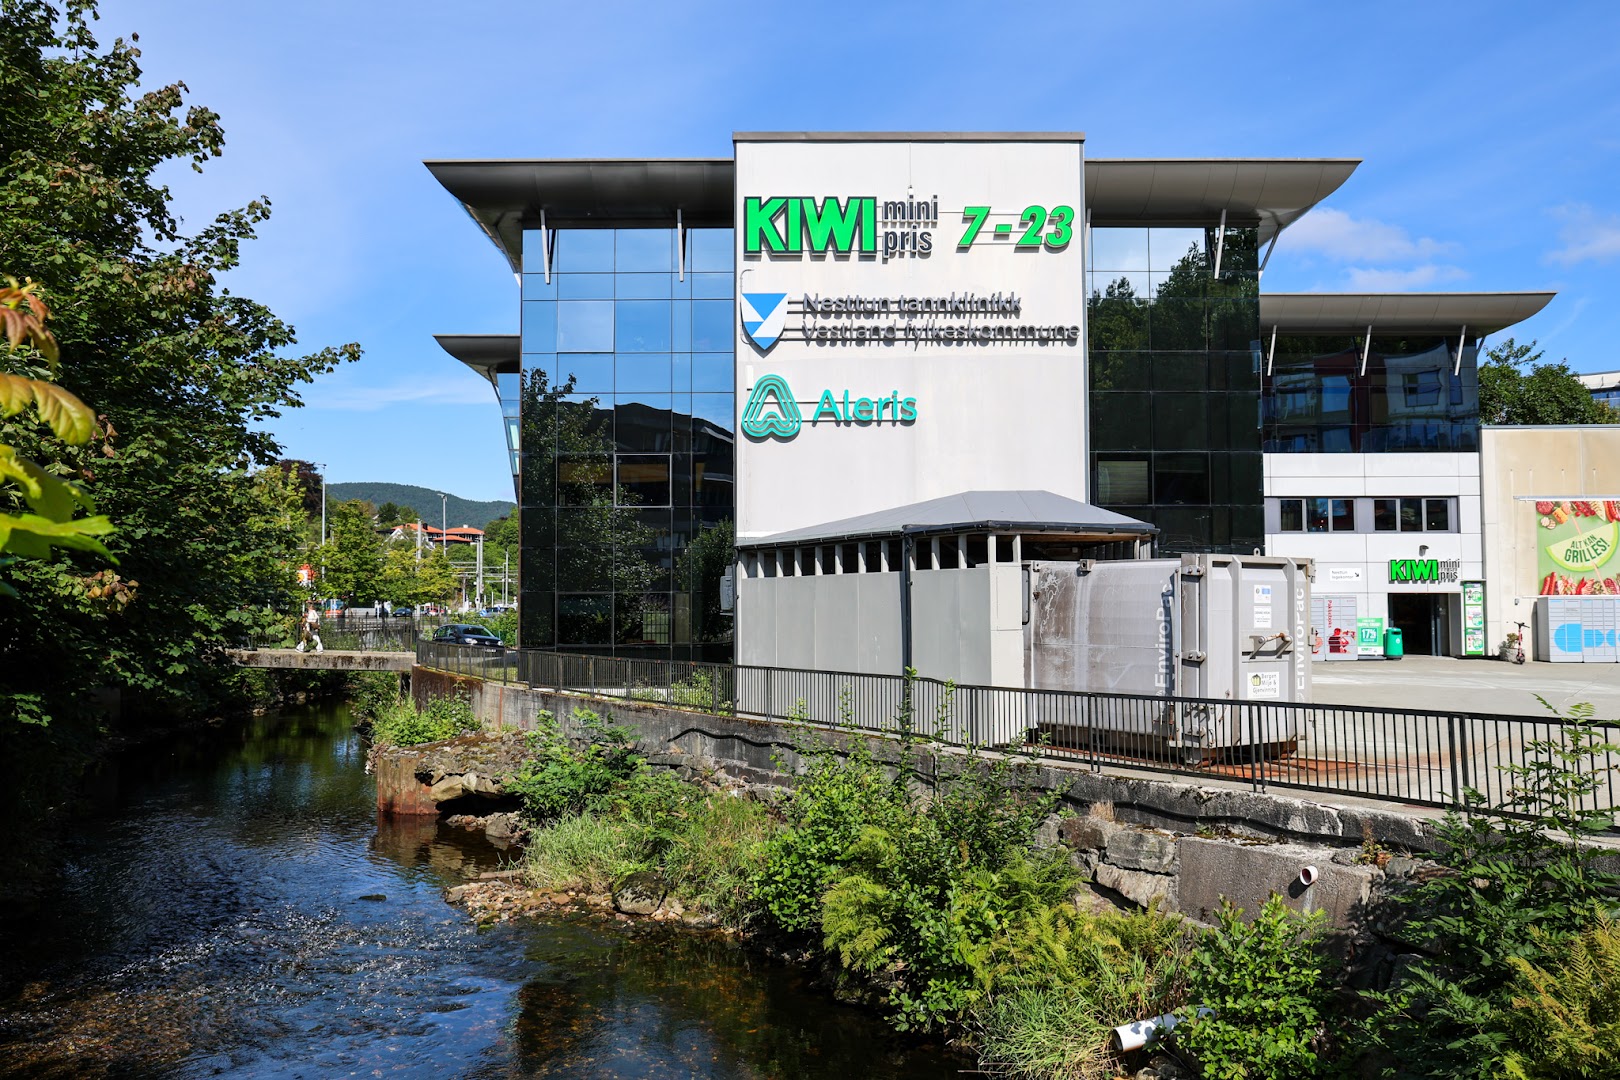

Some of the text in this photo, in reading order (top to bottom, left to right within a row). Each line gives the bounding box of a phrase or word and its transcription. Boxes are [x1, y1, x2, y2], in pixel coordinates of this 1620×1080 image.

[744, 195, 938, 254] KIWI mini
[884, 225, 933, 259] pris
[803, 291, 1022, 312] Nesttun tannklinikk
[802, 319, 1081, 351] Vestland fylkeskommune
[812, 389, 918, 421] Aleris
[1564, 537, 1611, 563] GRILLES!
[1570, 534, 1598, 550] ALT KAN
[1389, 558, 1460, 581] KIWI mini
[1440, 570, 1459, 583] pris
